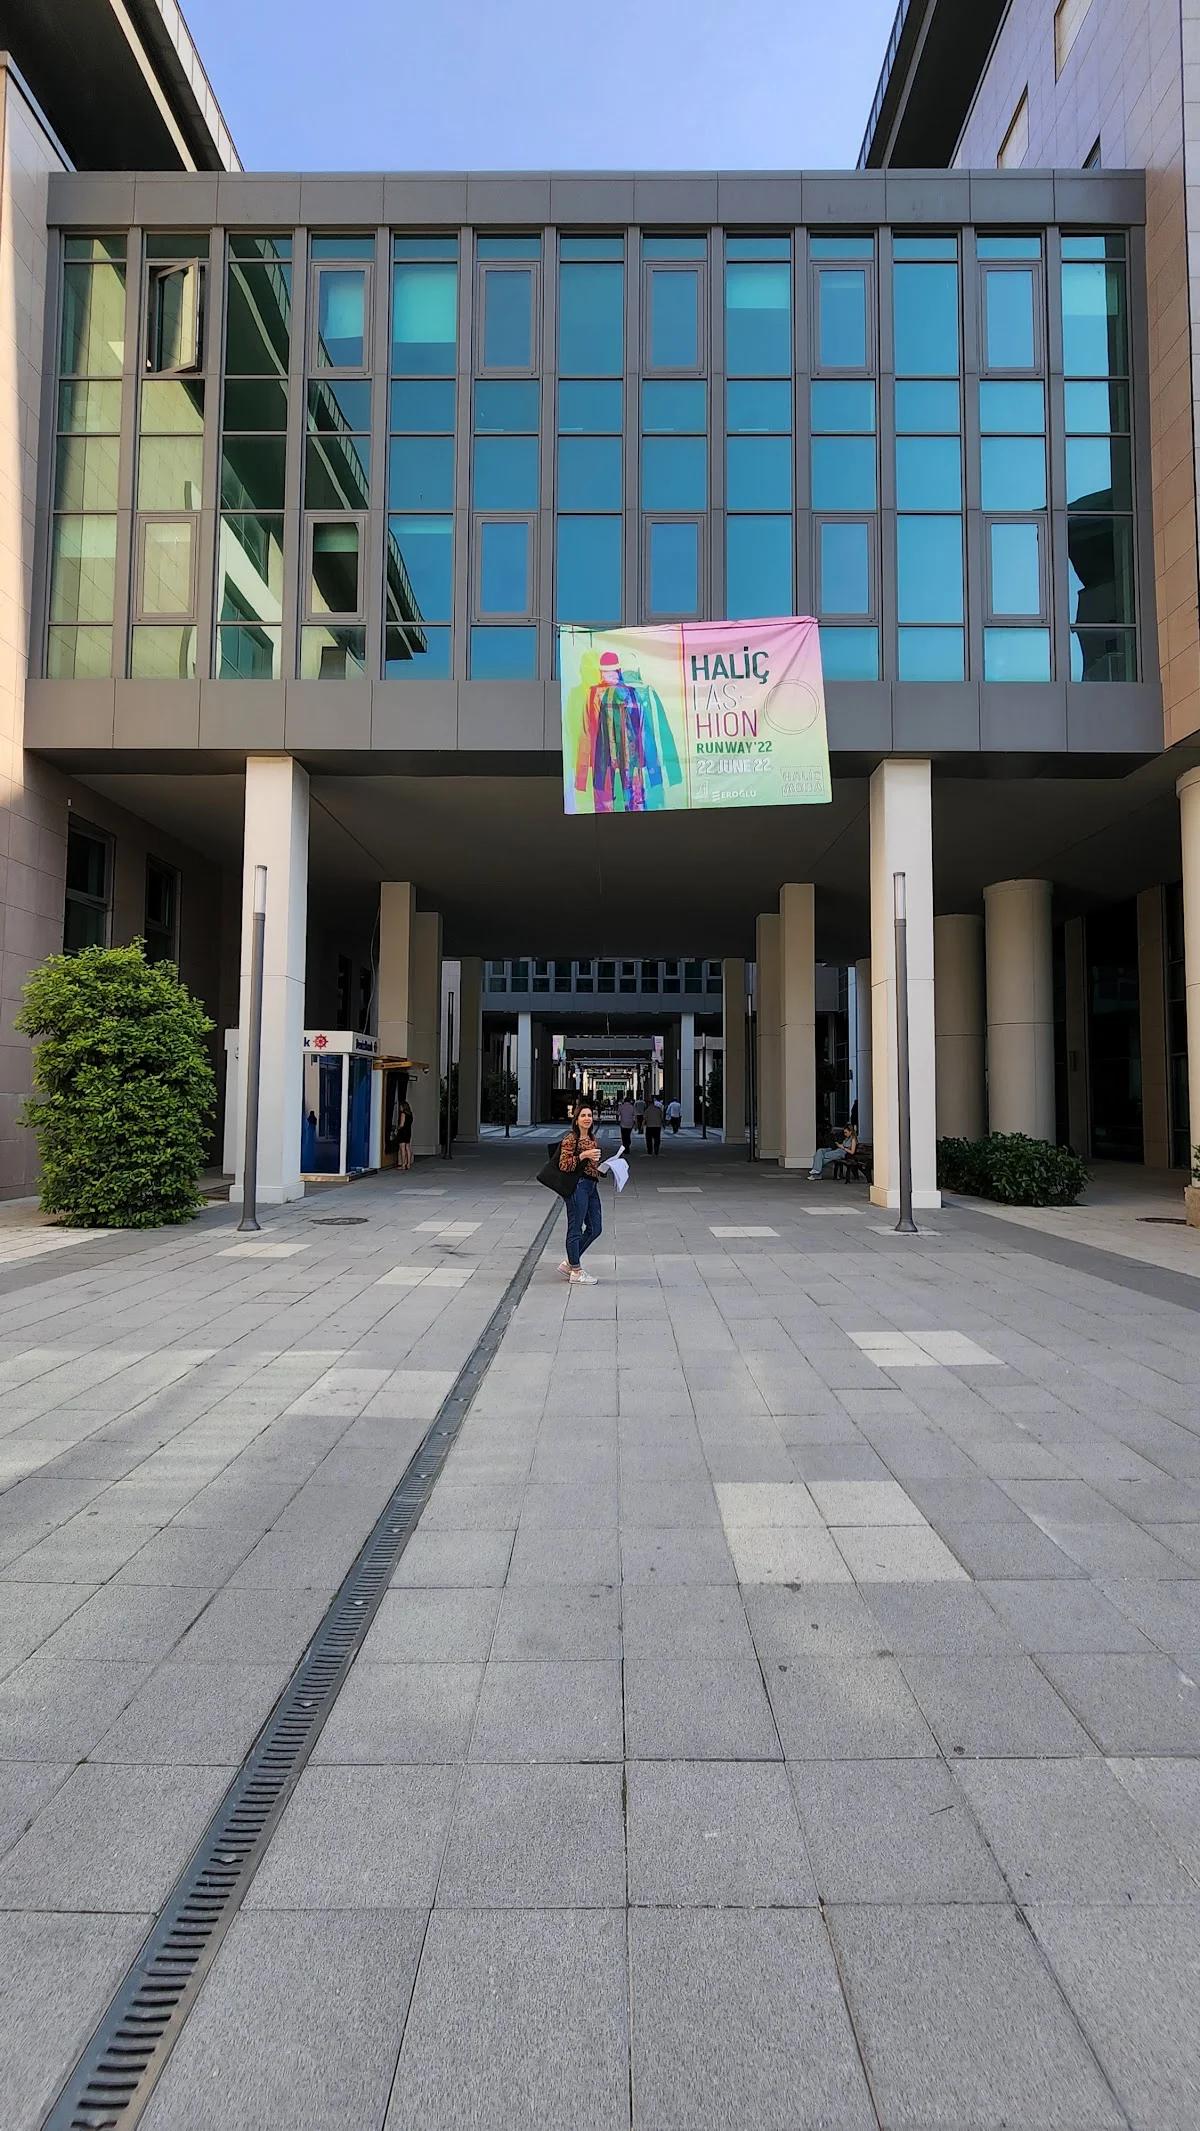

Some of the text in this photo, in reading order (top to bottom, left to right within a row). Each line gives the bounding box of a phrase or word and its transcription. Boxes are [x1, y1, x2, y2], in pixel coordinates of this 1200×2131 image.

[691, 646, 769, 684] HALİÇ
[696, 709, 758, 739] HION
[697, 757, 772, 774] 22 JUNE 22
